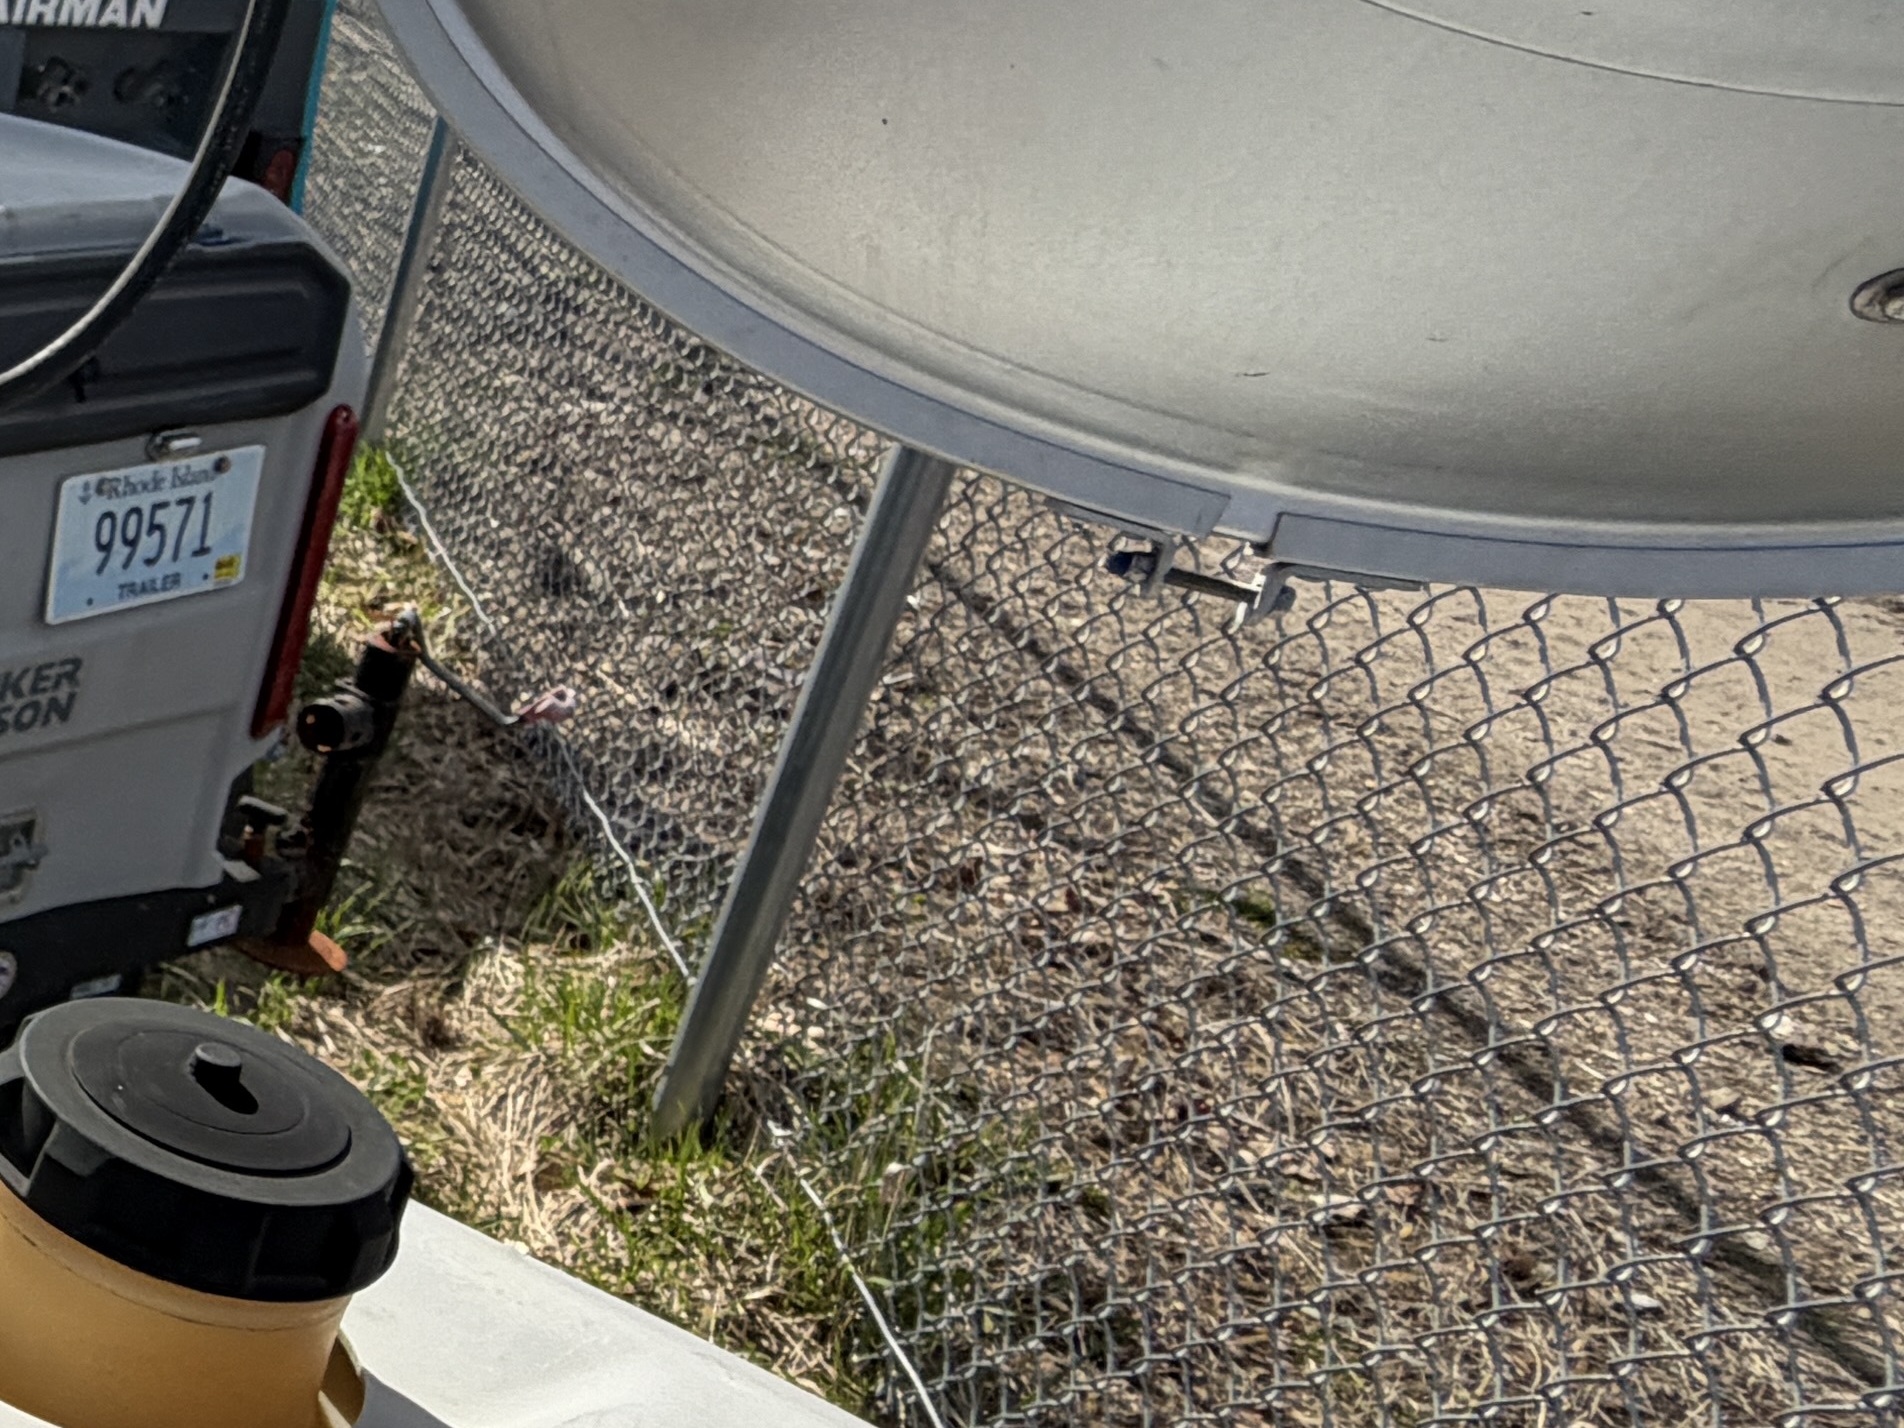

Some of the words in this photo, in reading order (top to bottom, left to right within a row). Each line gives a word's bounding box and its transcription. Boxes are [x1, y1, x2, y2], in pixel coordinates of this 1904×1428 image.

[105, 470, 168, 499] Rhode
[95, 489, 213, 576] 99571
[117, 572, 182, 600] TRAILER
